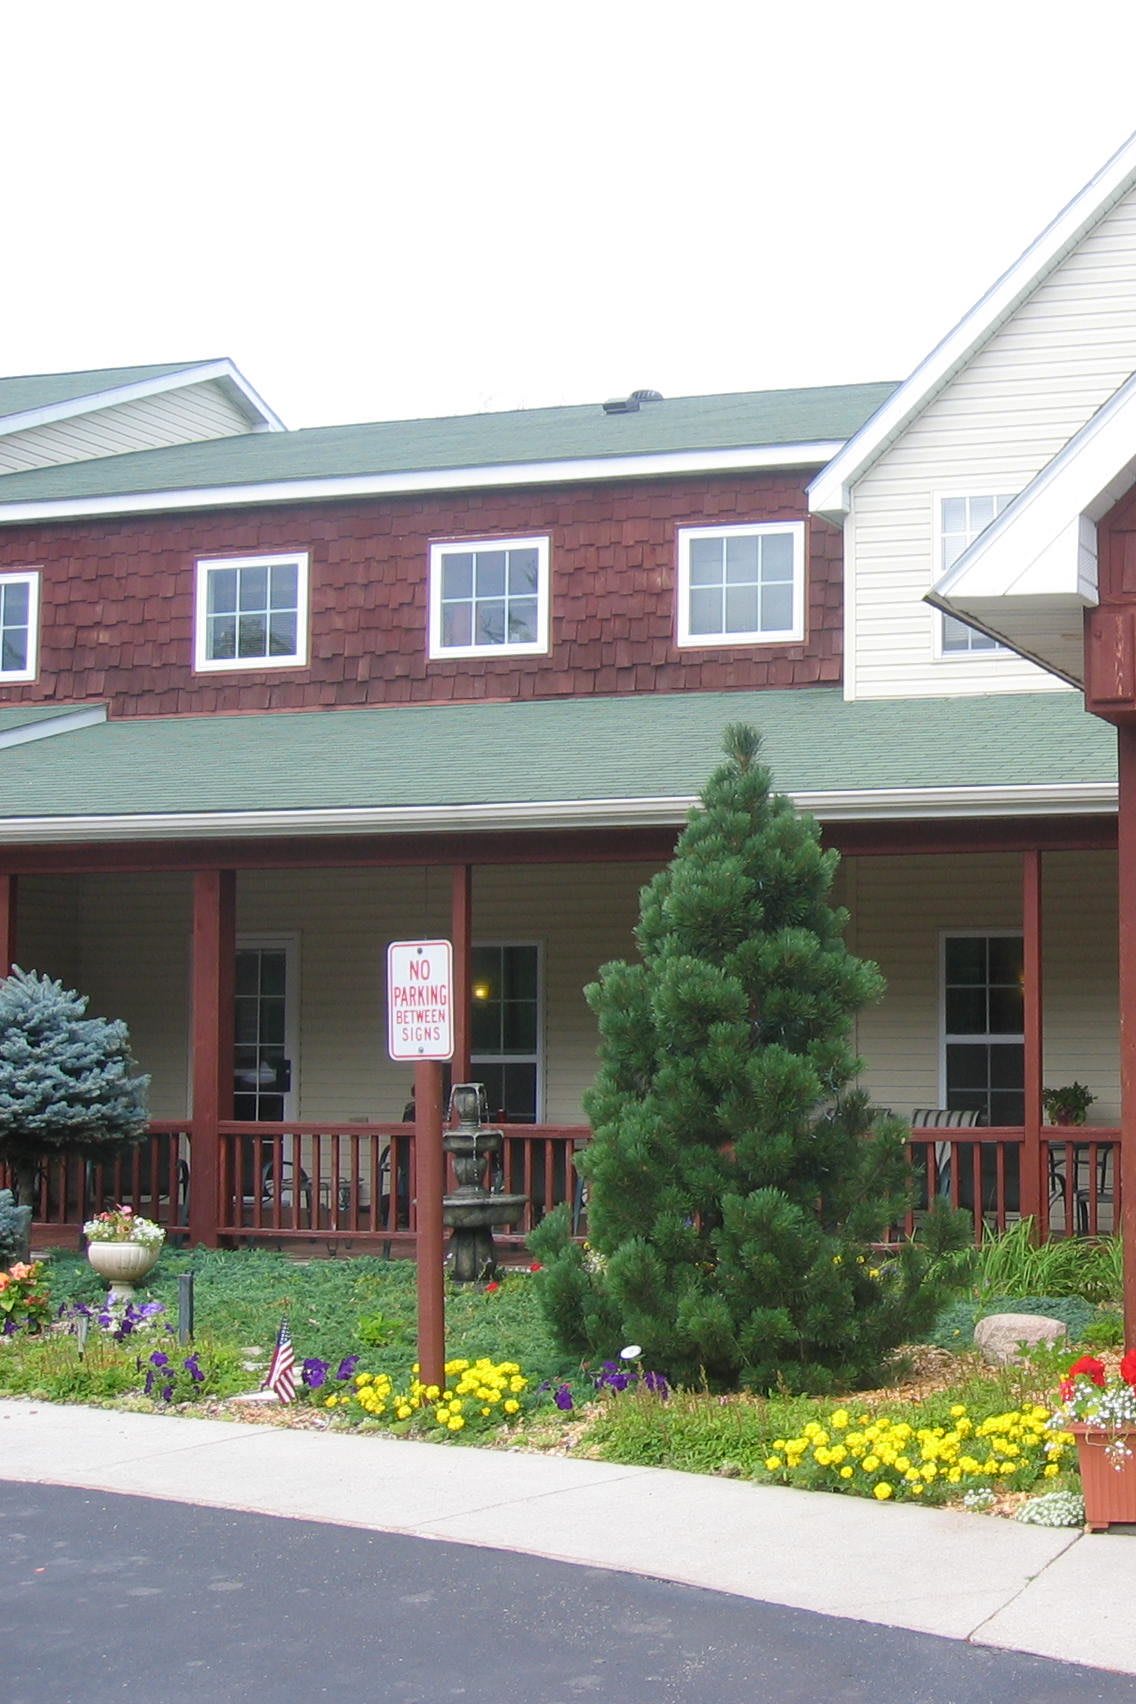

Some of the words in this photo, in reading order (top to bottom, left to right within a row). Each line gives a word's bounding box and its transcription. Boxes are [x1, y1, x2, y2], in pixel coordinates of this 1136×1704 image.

[409, 959, 431, 981] NO
[394, 984, 447, 1007] PARKING
[396, 1009, 446, 1025] BETWEEN
[402, 1026, 441, 1042] SIGNS
